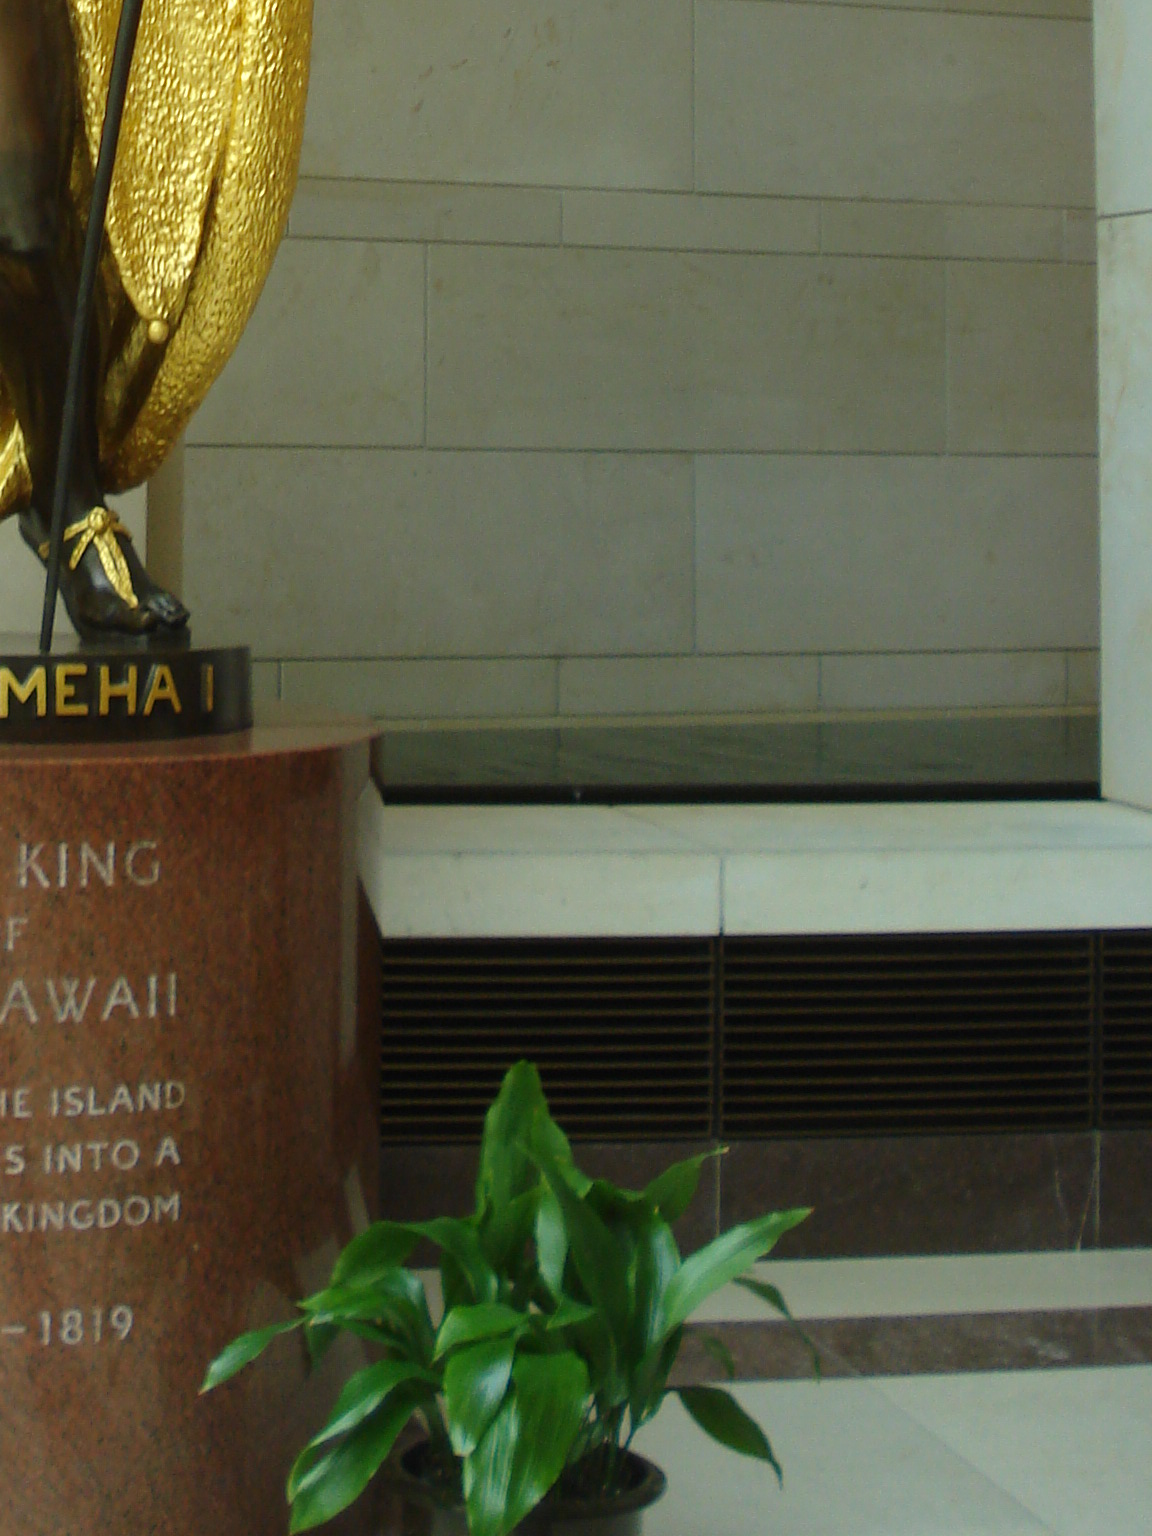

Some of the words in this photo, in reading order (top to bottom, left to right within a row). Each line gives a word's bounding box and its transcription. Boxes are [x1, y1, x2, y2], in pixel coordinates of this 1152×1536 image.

[18, 841, 161, 889] KING
[51, 1080, 186, 1116] ISLAND
[44, 1139, 140, 1173] INTO
[156, 1136, 181, 1166] A
[1, 1193, 181, 1232] KINGDOM
